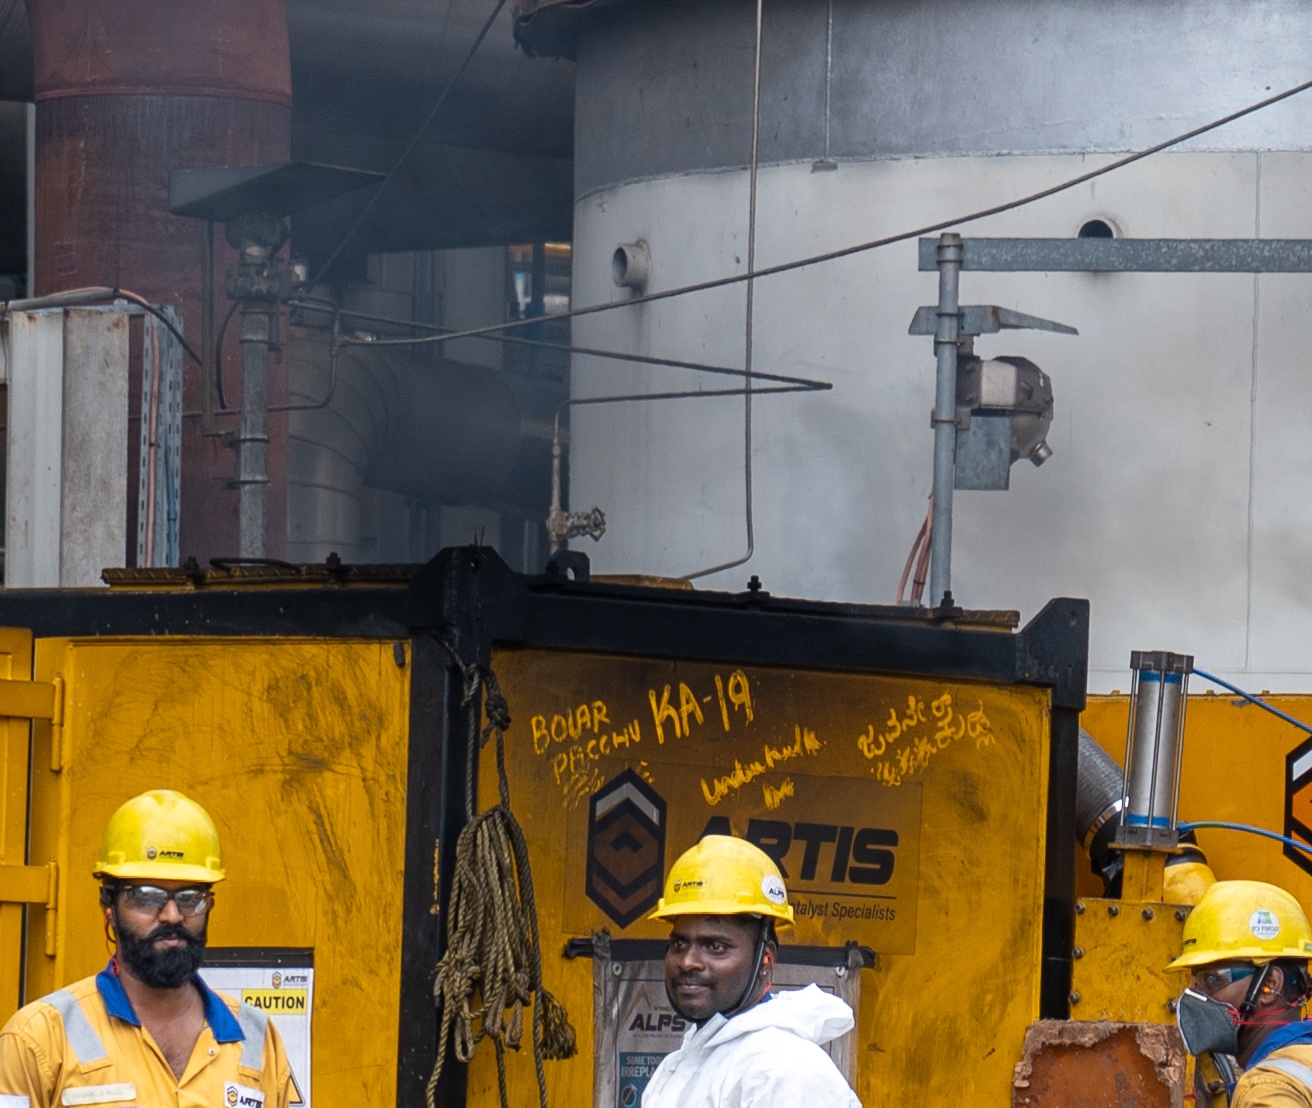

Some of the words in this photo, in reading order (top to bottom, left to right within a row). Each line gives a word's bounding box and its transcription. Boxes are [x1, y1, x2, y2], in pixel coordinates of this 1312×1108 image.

[648, 668, 754, 745] KA-19
[791, 902, 830, 921] talyst
[831, 902, 896, 921] Specialists
[283, 975, 308, 983] ARTIS
[244, 996, 306, 1010] CAUTION
[629, 1013, 686, 1032] ALPS
[626, 1055, 645, 1066] SOME
[239, 1095, 263, 1108] ARTIS
